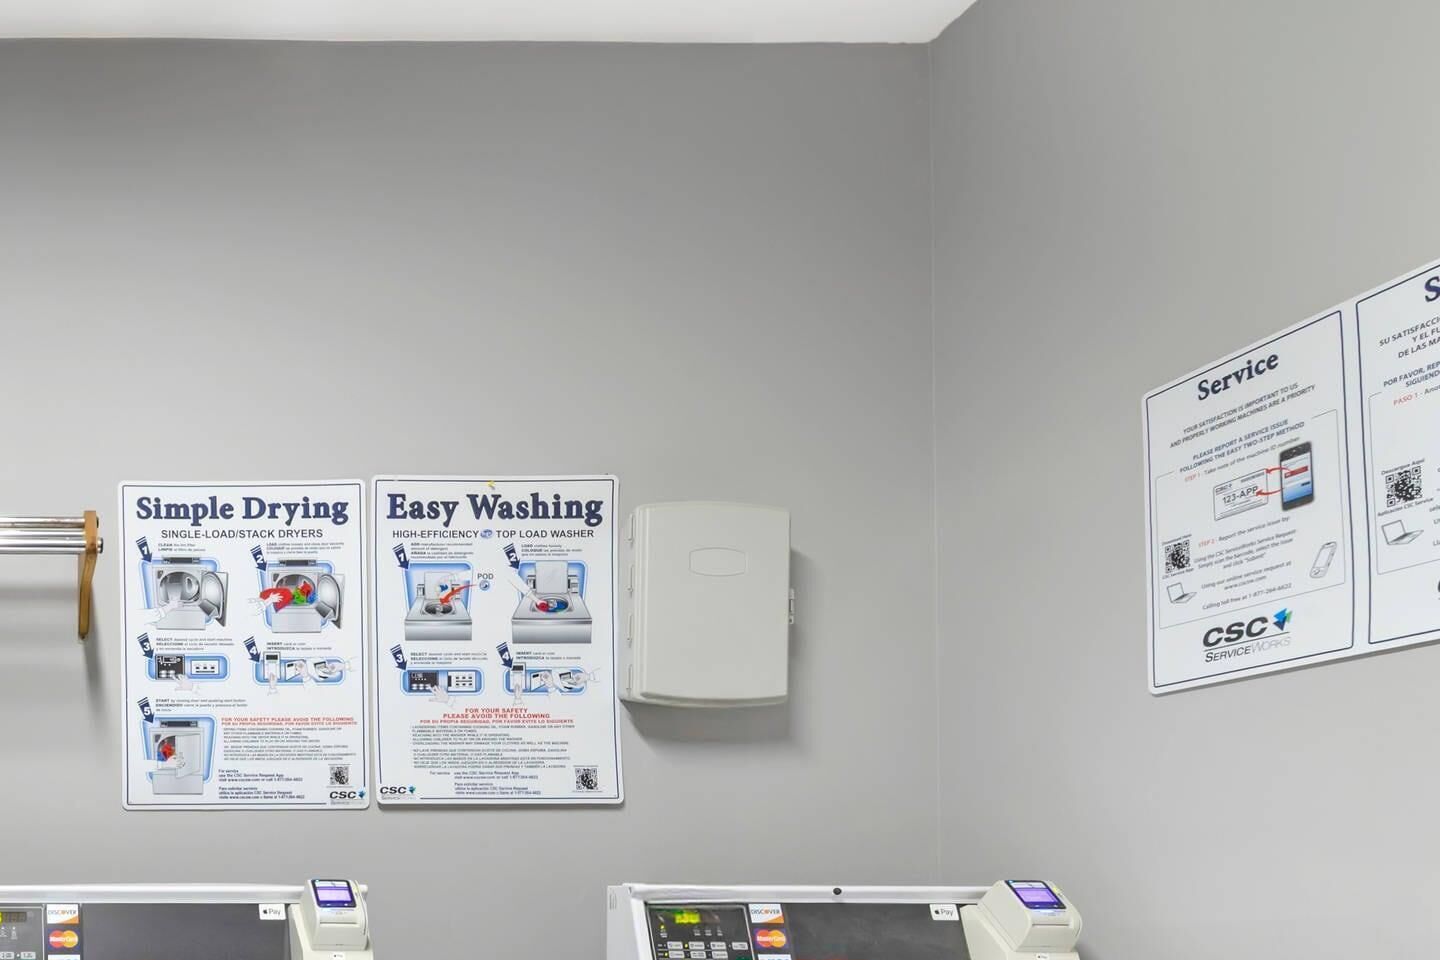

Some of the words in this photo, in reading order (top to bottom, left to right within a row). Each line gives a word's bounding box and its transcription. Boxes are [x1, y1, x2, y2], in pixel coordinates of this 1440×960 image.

[1420, 331, 1429, 341] EL
[1379, 337, 1391, 347] SU
[1398, 349, 1409, 358] DE
[1411, 342, 1427, 353] LAS
[1198, 354, 1279, 400] Service
[1383, 377, 1398, 387] POR
[1183, 424, 1199, 434] YOUR
[1199, 408, 1237, 427] SATISFACTION
[1245, 390, 1279, 408] IMPORTANT
[1280, 386, 1289, 394] TO
[1289, 382, 1298, 390] US
[1170, 439, 1182, 448] AND
[1182, 428, 1209, 443] PROPERLY
[1210, 417, 1237, 432] WORKING
[1237, 403, 1268, 420] MACHINES
[1269, 399, 1280, 408] ARE
[1286, 384, 1315, 401] PRIORITY
[1193, 447, 1213, 460] PLEASE
[1214, 438, 1237, 452] REPORT
[1244, 427, 1268, 440] SERVICE
[1270, 419, 1288, 430] ISSUE
[1180, 456, 1214, 472] FOLLOWING
[1215, 451, 1225, 460] THE
[1226, 445, 1242, 456] EASY
[1276, 421, 1304, 436] METHOD
[1222, 485, 1259, 504] 123-APP
[136, 496, 234, 526] Simple
[242, 496, 349, 526] Drying
[386, 493, 459, 527] Easy
[466, 492, 603, 527] Washing
[161, 529, 275, 539] SINGLE-LOAD/STACK
[278, 528, 323, 539] DRYERS
[392, 530, 478, 539] HIGH-EFFICIENCY
[496, 530, 516, 538] TOP
[519, 530, 547, 538] LOAD
[550, 529, 594, 538] WASHER
[255, 554, 264, 564] 2
[509, 553, 517, 563] 2
[1203, 616, 1269, 648] CSC
[143, 641, 151, 651] 3
[396, 653, 403, 663] 3
[144, 707, 152, 716] 5
[380, 785, 407, 794] CSC
[329, 791, 357, 799] CSC
[268, 908, 281, 916] Pay
[940, 908, 954, 917] Pay
